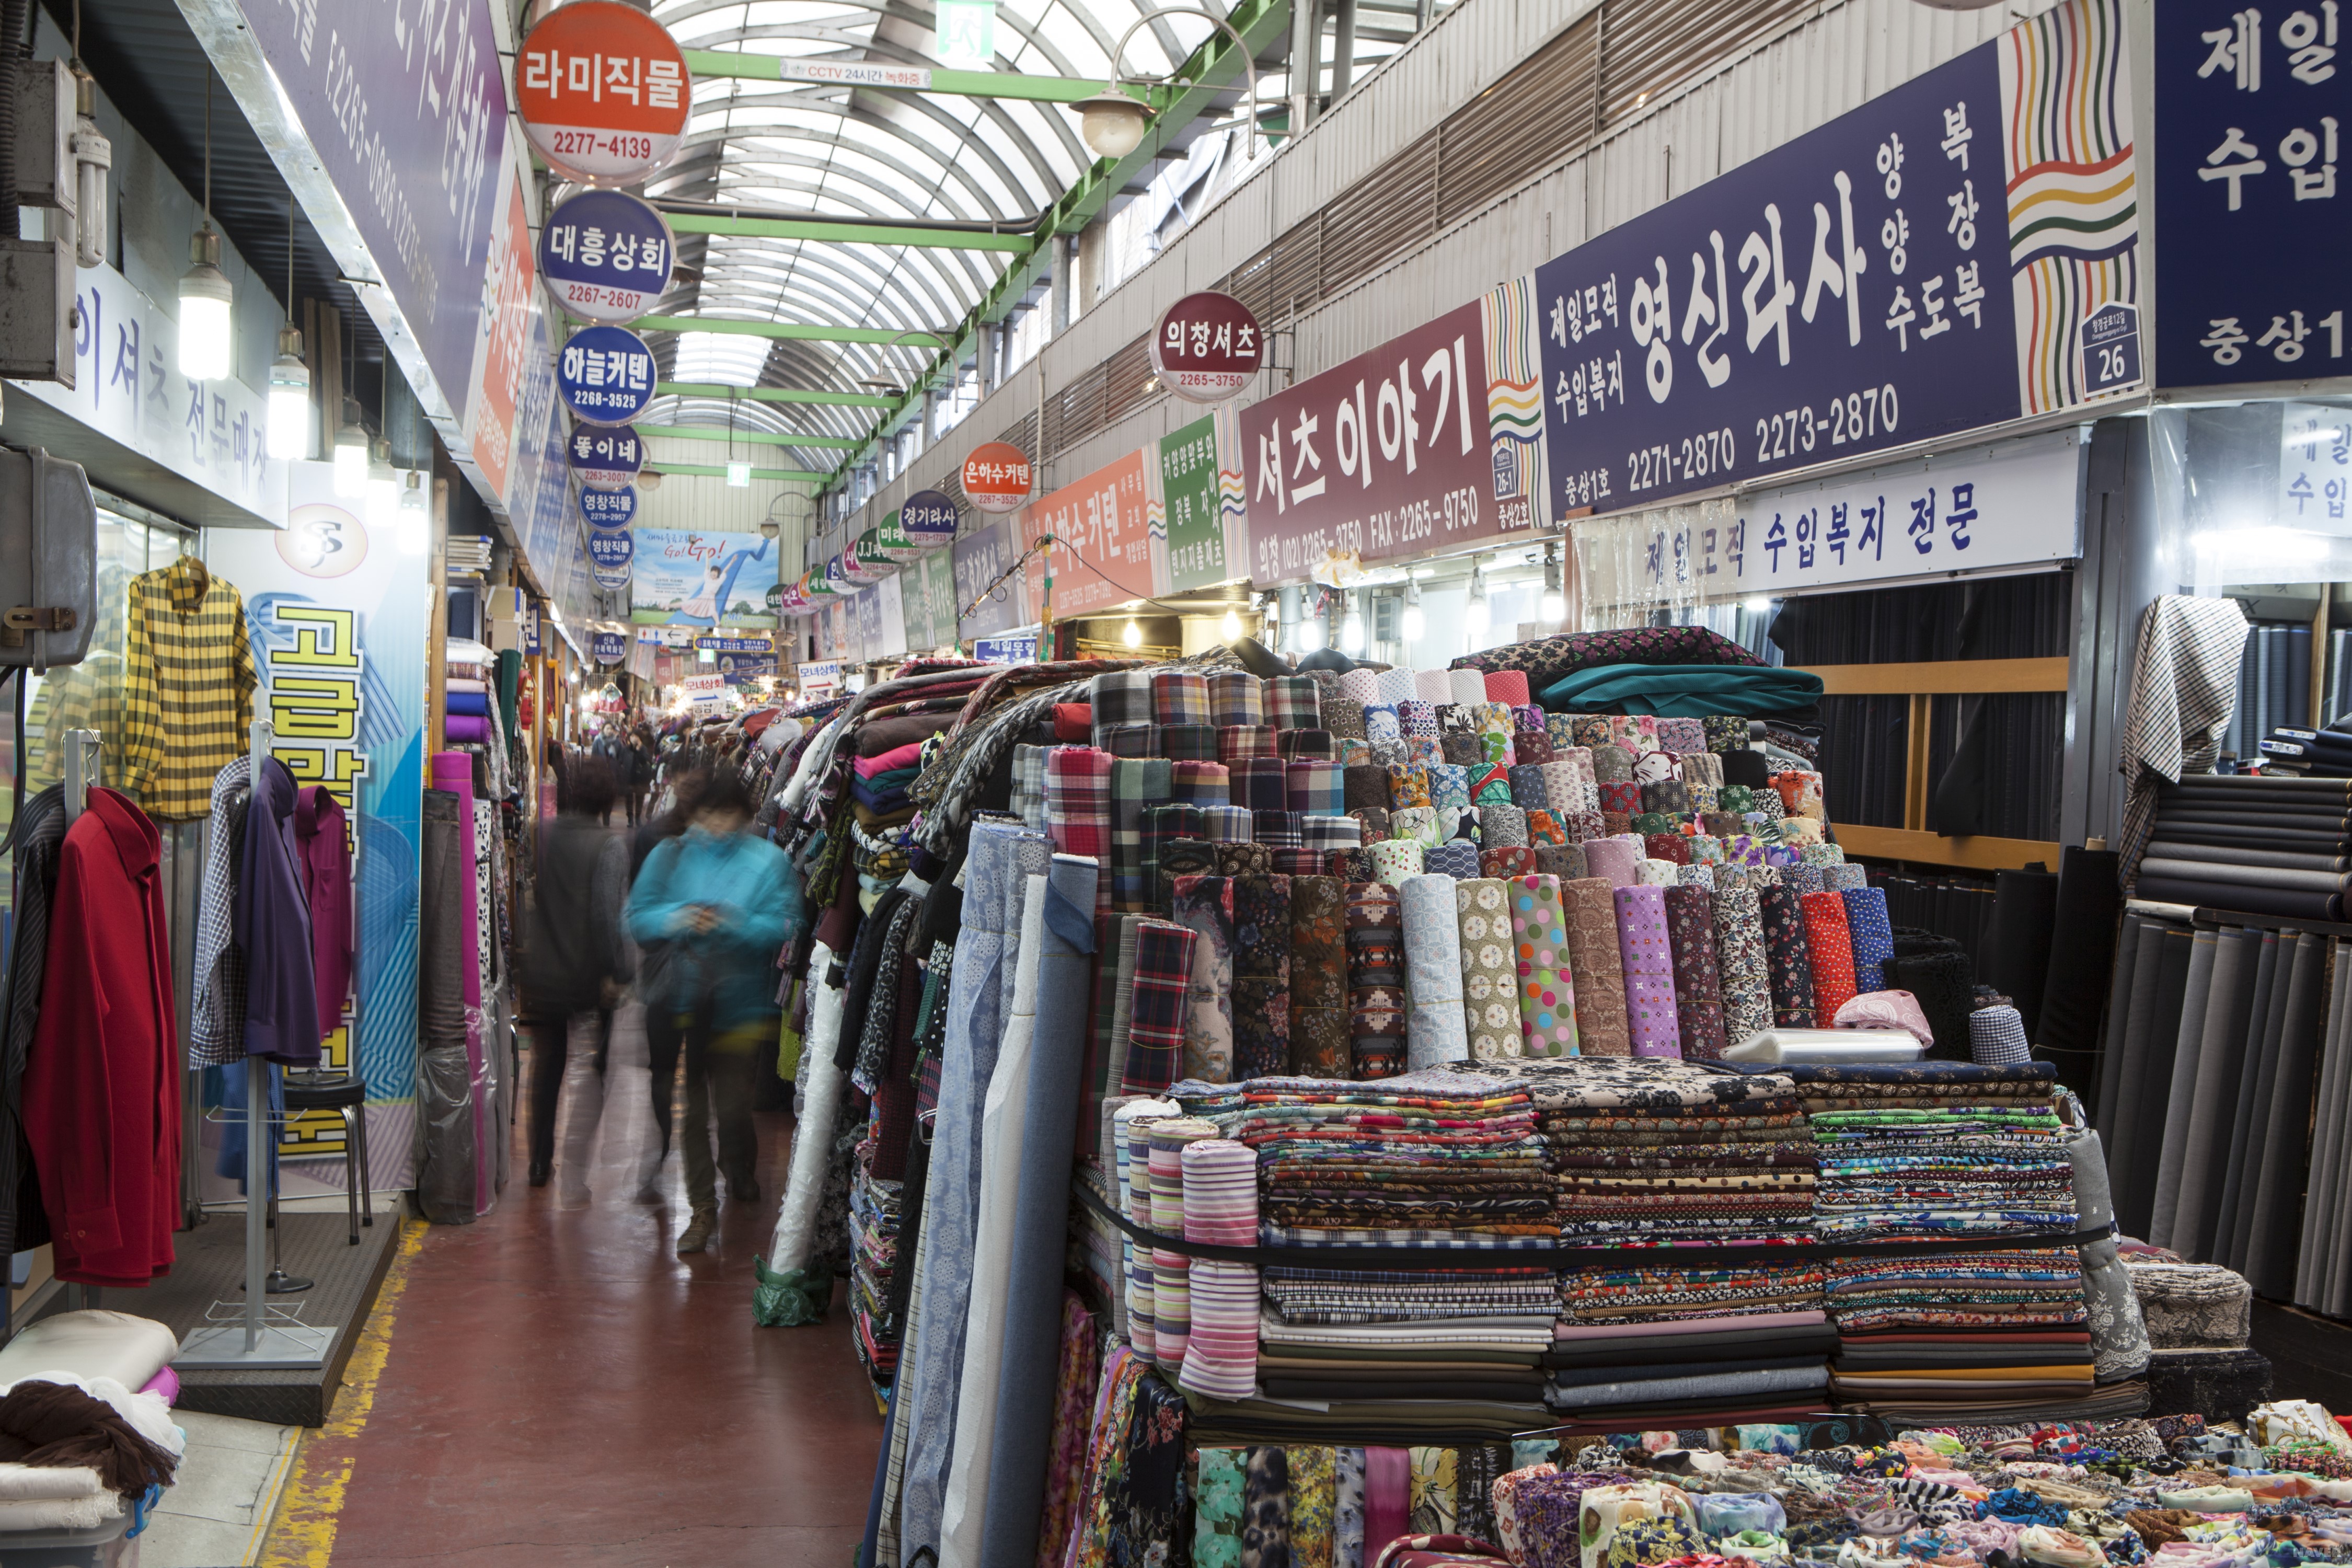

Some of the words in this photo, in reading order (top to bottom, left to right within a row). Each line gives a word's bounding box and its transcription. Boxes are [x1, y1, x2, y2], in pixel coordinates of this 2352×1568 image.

[2197, 0, 2352, 93] 제일
[526, 50, 683, 109] 라미직물
[809, 66, 841, 79] CCTV
[845, 68, 882, 82] 24시간
[885, 71, 920, 85] 녹화중
[554, 131, 651, 159] 2277-4139
[550, 225, 666, 276] 대흥상회
[568, 284, 641, 311] 2267-2607
[1629, 169, 1867, 405] 영신라사
[1549, 272, 1619, 349] 제일모직
[2092, 311, 2125, 333] 창경궁로12길
[1165, 319, 1255, 359] 의창셔츠
[2199, 310, 2352, 366] 중상1
[564, 346, 648, 390] 하늘커텐
[2099, 344, 2125, 383] 26
[1180, 373, 1243, 387] 2265-3750
[1554, 349, 1625, 425] 수입복지
[575, 390, 637, 409] 2268-3525
[574, 436, 636, 463] 똘이네
[1628, 426, 1735, 493] 2271-2870
[1756, 383, 1899, 465] 2273-2870
[585, 470, 626, 483] 2263-3007
[965, 463, 1029, 485] 은하수커텐
[1121, 469, 1142, 497] 사무실
[1497, 471, 1513, 493] 26-1
[1564, 466, 1612, 506] 중상1호
[585, 494, 631, 511] 영창직물
[979, 494, 1018, 505] 2267-3525
[591, 513, 626, 521] 2278-2957
[904, 508, 955, 526] 경기라사
[1498, 502, 1529, 529] 중상2호
[880, 526, 905, 543] 미래
[914, 532, 947, 541] 2275-1733
[1044, 483, 1122, 578] 은하수커텐
[1647, 518, 1746, 585] 제일모직
[1763, 494, 1886, 574] 수입복지
[1908, 480, 1978, 556] 전문
[593, 540, 630, 554] 영창직물
[664, 545, 686, 559] Go!
[687, 537, 727, 561] Go!
[1125, 539, 1148, 566] 개업상담
[1259, 533, 1279, 582] 의창
[1283, 537, 1301, 571] (02)
[1302, 519, 1362, 566] 2265-3750
[686, 677, 724, 691] 모녀상회
[800, 664, 839, 678] 모녀상회
